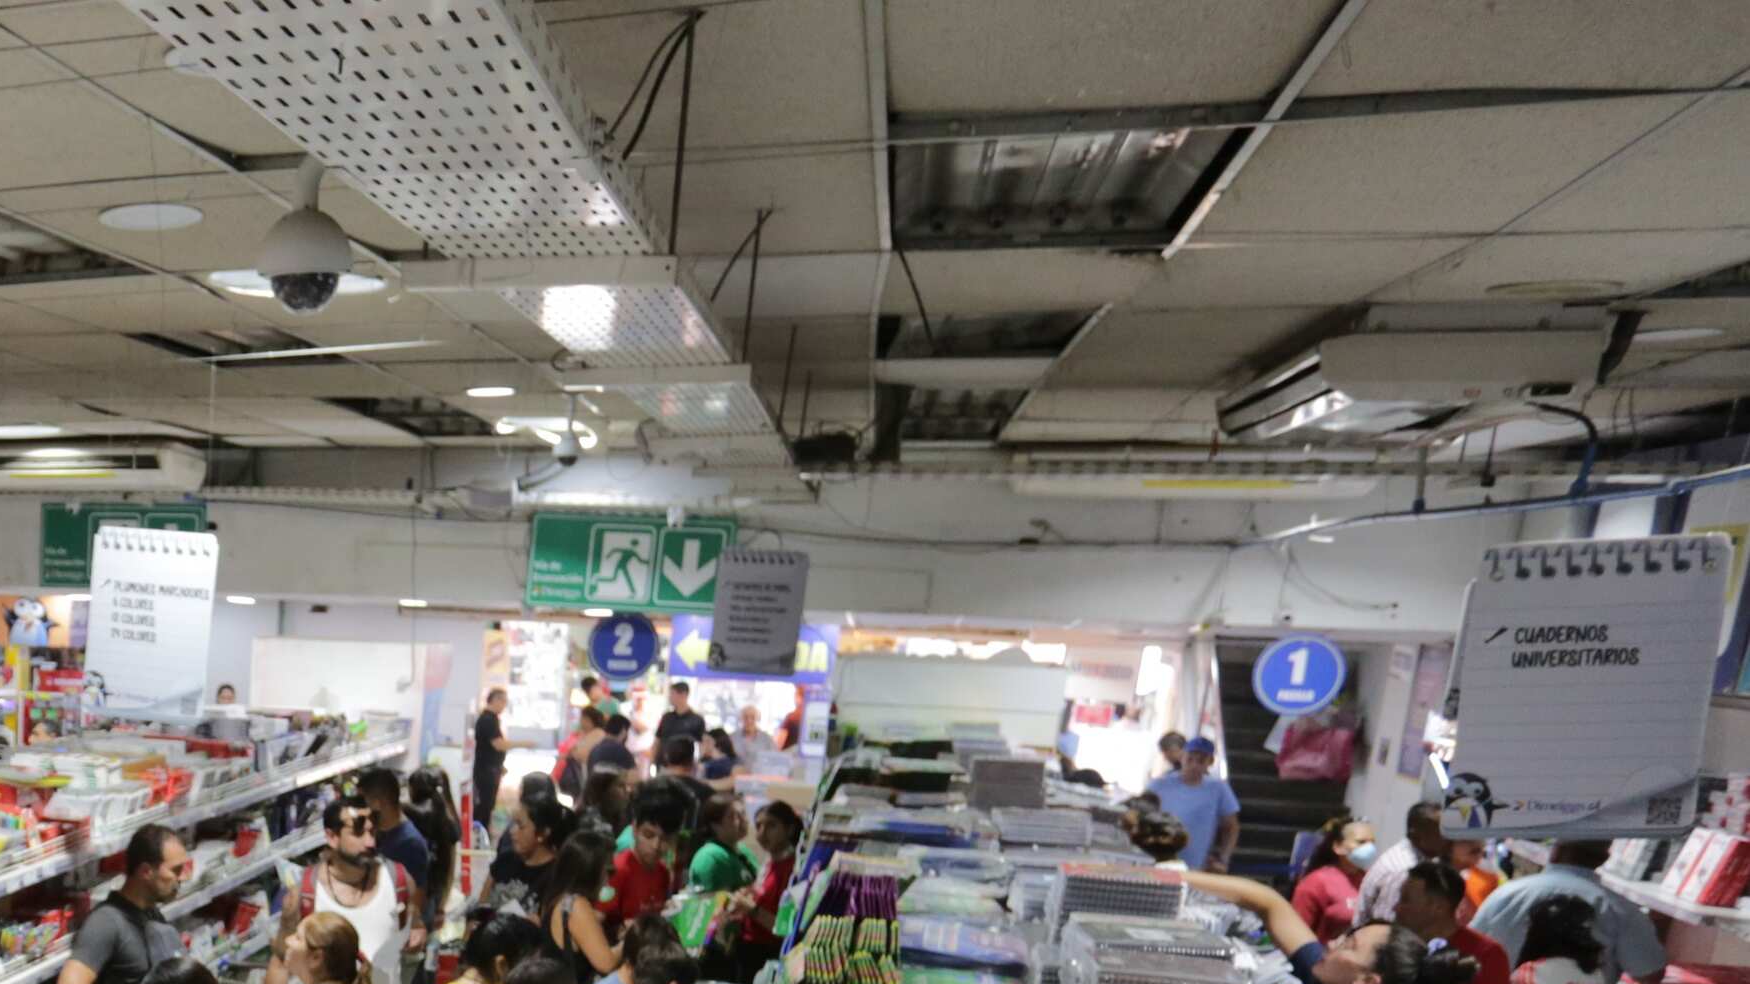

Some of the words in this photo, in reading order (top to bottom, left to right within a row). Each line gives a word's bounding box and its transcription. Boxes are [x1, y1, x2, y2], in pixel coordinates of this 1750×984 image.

[613, 622, 635, 656] 2
[1514, 624, 1609, 644] CUADERNOS
[1288, 648, 1309, 686] 1
[1511, 647, 1640, 668] UNIVERSITARIOS
